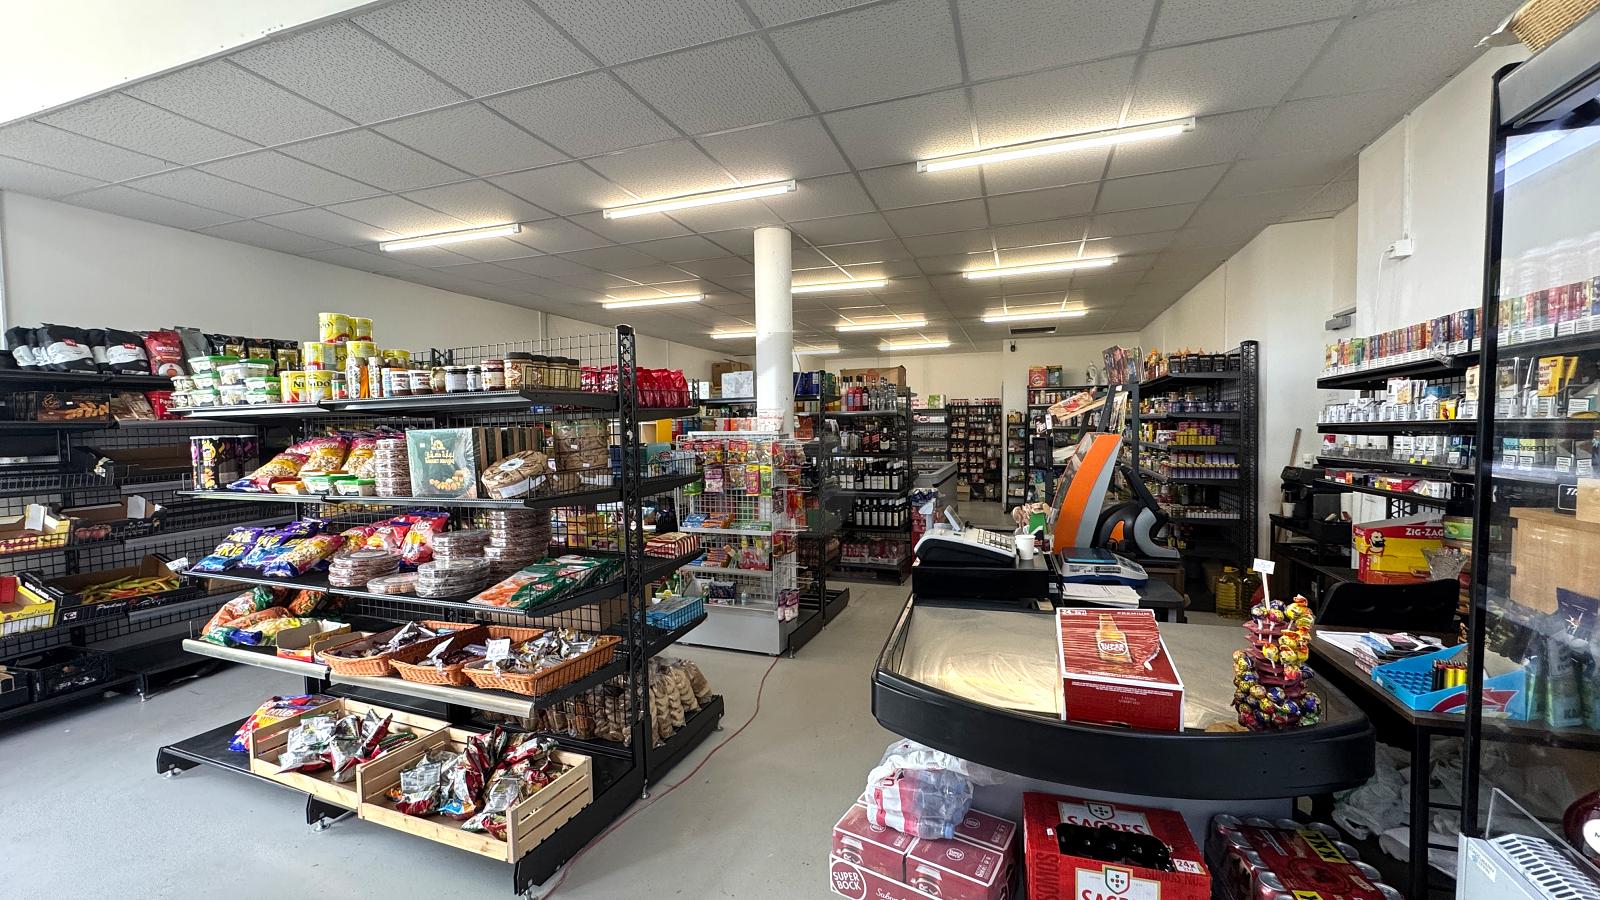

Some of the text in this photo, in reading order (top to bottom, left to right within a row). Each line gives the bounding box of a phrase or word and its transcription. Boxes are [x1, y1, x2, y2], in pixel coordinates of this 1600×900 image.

[1405, 527, 1444, 537] ZIG-ZAG
[832, 871, 860, 881] SUPER
[836, 881, 862, 890] BOCK
